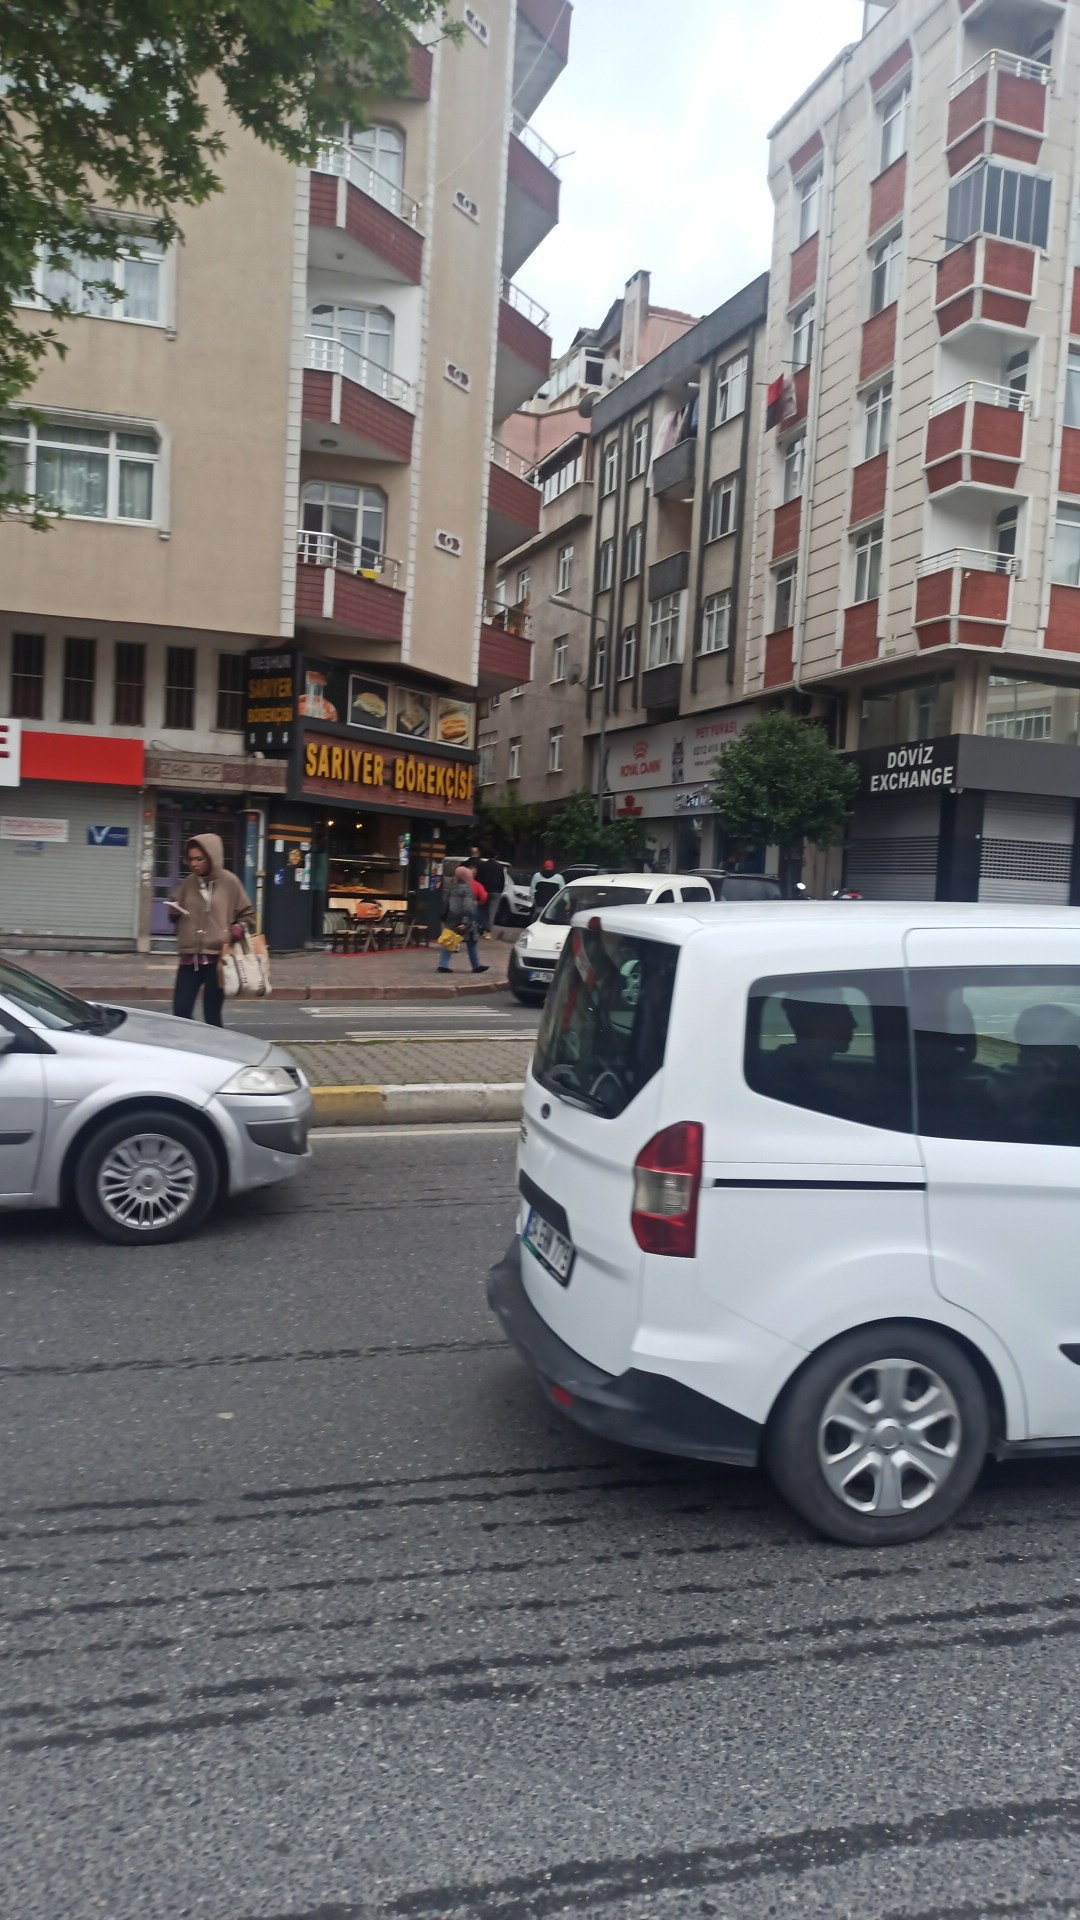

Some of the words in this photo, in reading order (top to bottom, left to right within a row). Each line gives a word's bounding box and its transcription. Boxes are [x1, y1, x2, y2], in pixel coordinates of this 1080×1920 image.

[248, 678, 292, 698] SARIYER
[887, 743, 934, 769] DÖVİZ
[306, 743, 384, 786] SARIYER
[394, 754, 473, 805] BÖREKÇİSİ
[870, 766, 954, 792] EXCHANGE
